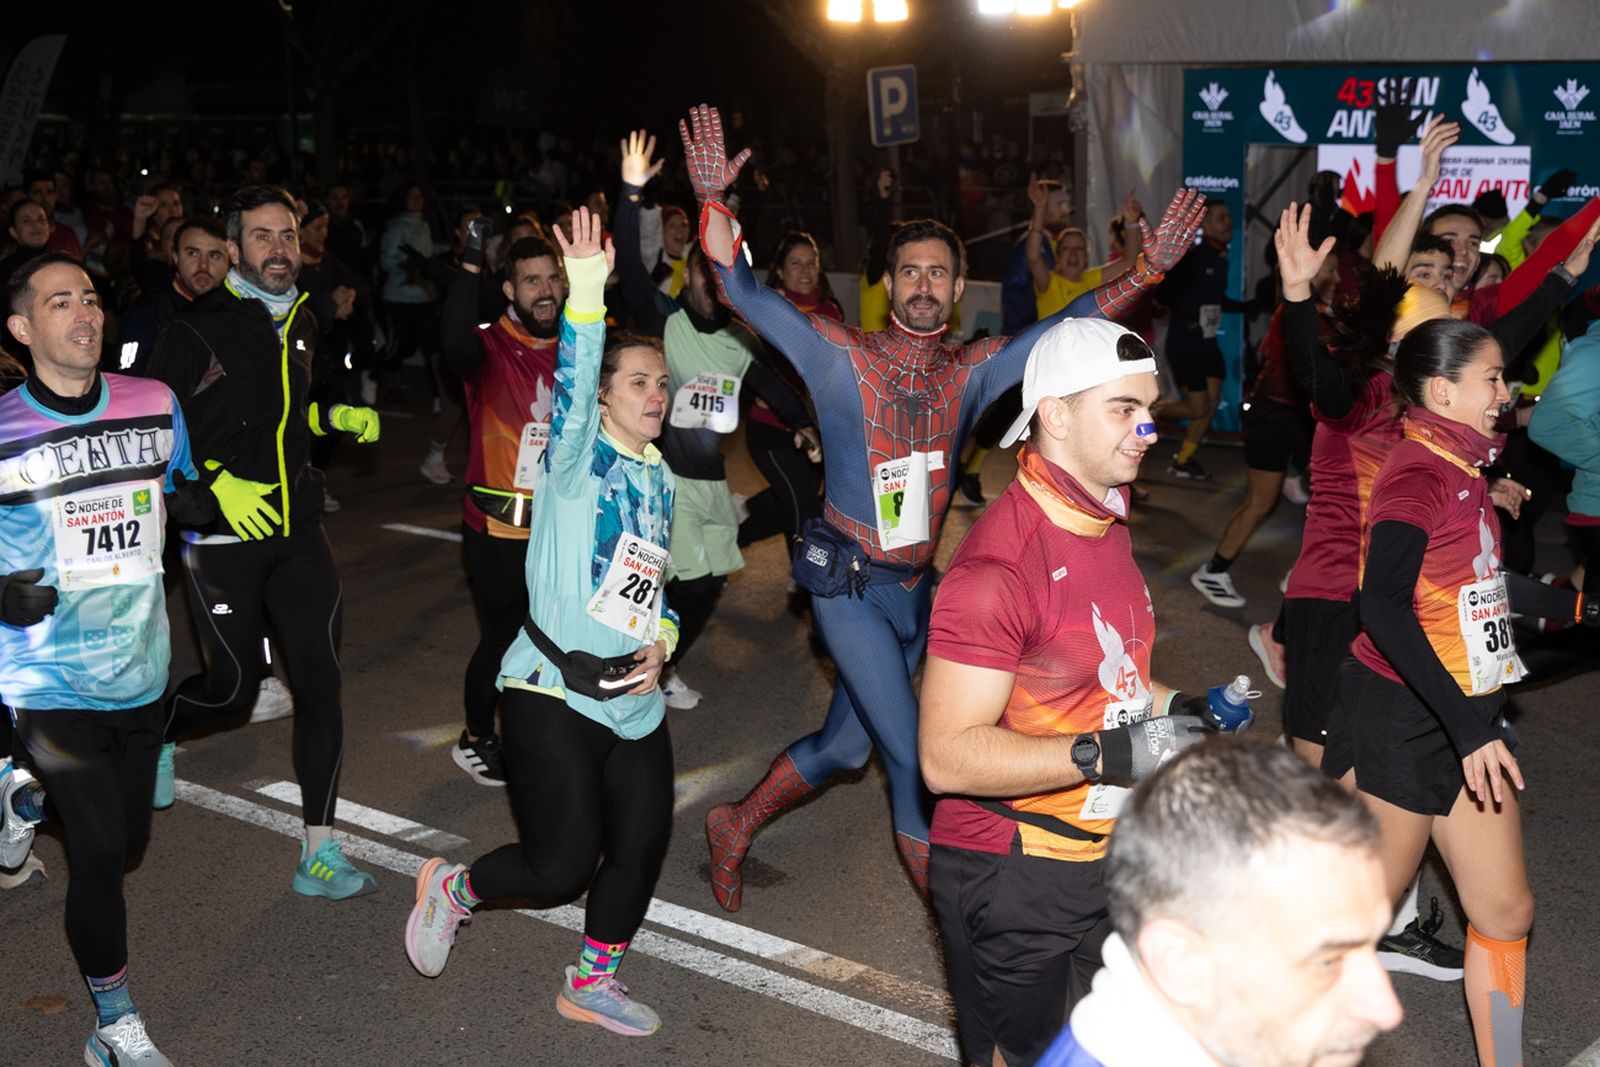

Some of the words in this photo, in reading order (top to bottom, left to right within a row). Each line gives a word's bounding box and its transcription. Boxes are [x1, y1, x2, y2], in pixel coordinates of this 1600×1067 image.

[1336, 77, 1376, 109] 43
[880, 76, 908, 136] P
[1274, 110, 1292, 131] 43
[1477, 111, 1498, 132] 43
[690, 392, 724, 413] 4115
[884, 481, 901, 493] SAN
[79, 501, 110, 513] NOCHE
[112, 498, 123, 508] DE
[67, 516, 88, 528] SAN
[91, 508, 125, 524] ANTÓN
[82, 520, 141, 555] 7412
[623, 557, 641, 572] SAN
[1472, 607, 1490, 621] SAN
[1116, 665, 1137, 699] 43
[1155, 718, 1168, 738] SAN
